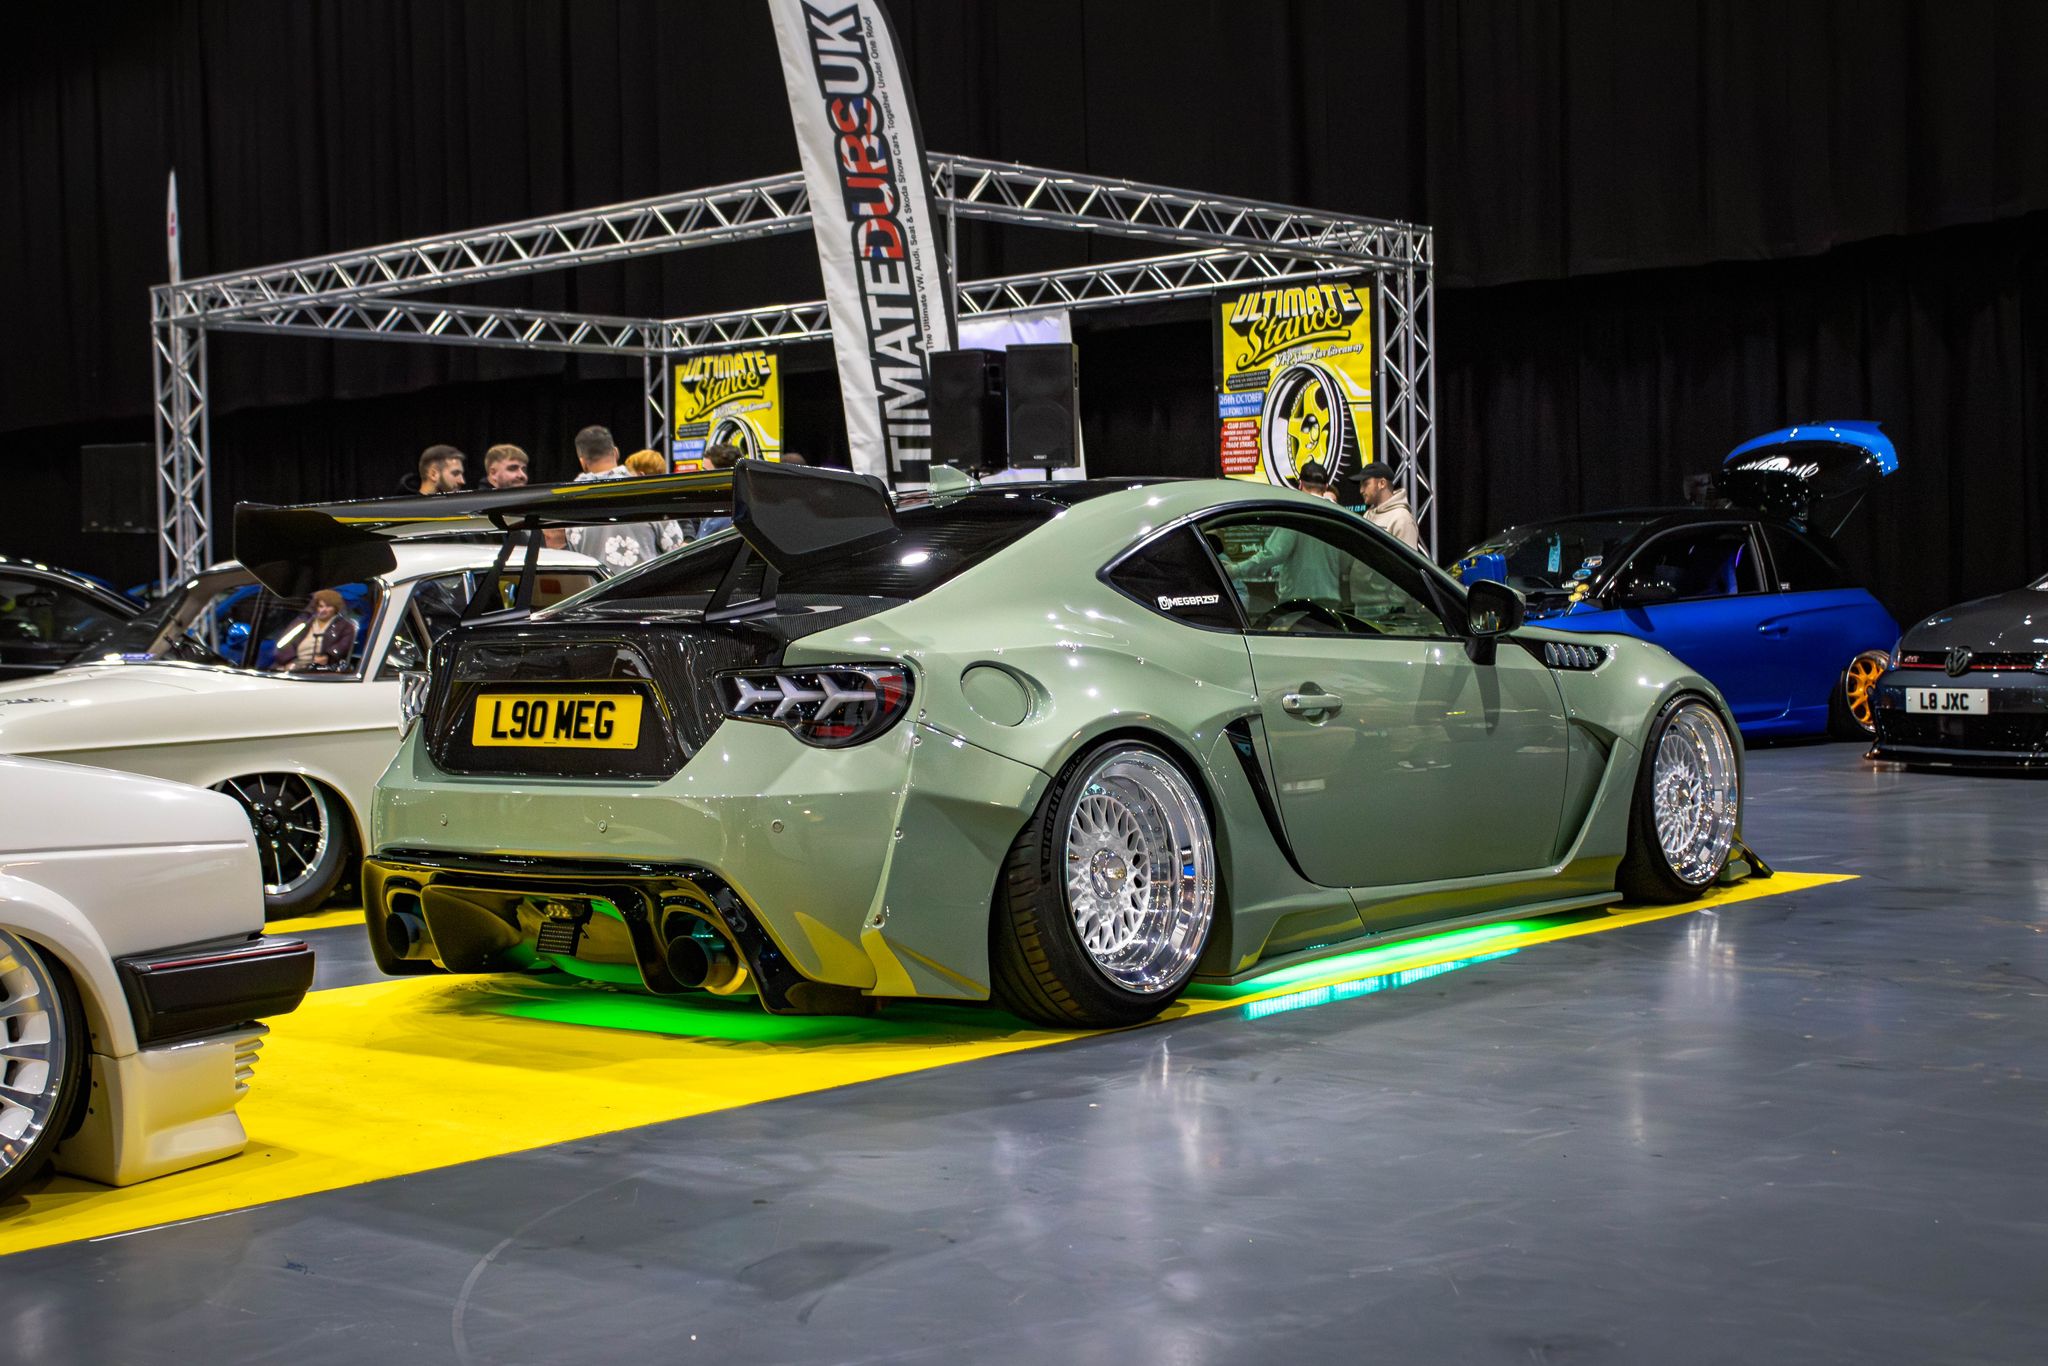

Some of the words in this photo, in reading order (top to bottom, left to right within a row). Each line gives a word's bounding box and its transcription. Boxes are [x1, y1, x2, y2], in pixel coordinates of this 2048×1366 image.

[863, 16, 873, 38] Roof
[870, 38, 879, 59] One
[875, 61, 886, 89] Under
[881, 91, 896, 130] Together
[890, 132, 900, 156] Cars,
[896, 158, 906, 183] Show
[901, 185, 912, 214] Skoda
[914, 248, 922, 272] Audi,
[917, 273, 926, 293] VW,
[919, 293, 931, 331] Ultimate
[1230, 283, 1362, 324] ULTIMATE
[926, 332, 935, 350] The
[1237, 307, 1343, 370] Stance
[682, 350, 772, 383] ULTIMATE
[685, 372, 760, 421] Stance
[1235, 392, 1262, 404] OCTOBER
[1919, 692, 1938, 710] L8
[1941, 692, 1970, 711] JXC
[490, 700, 549, 739] L90
[553, 700, 616, 740] MEG
